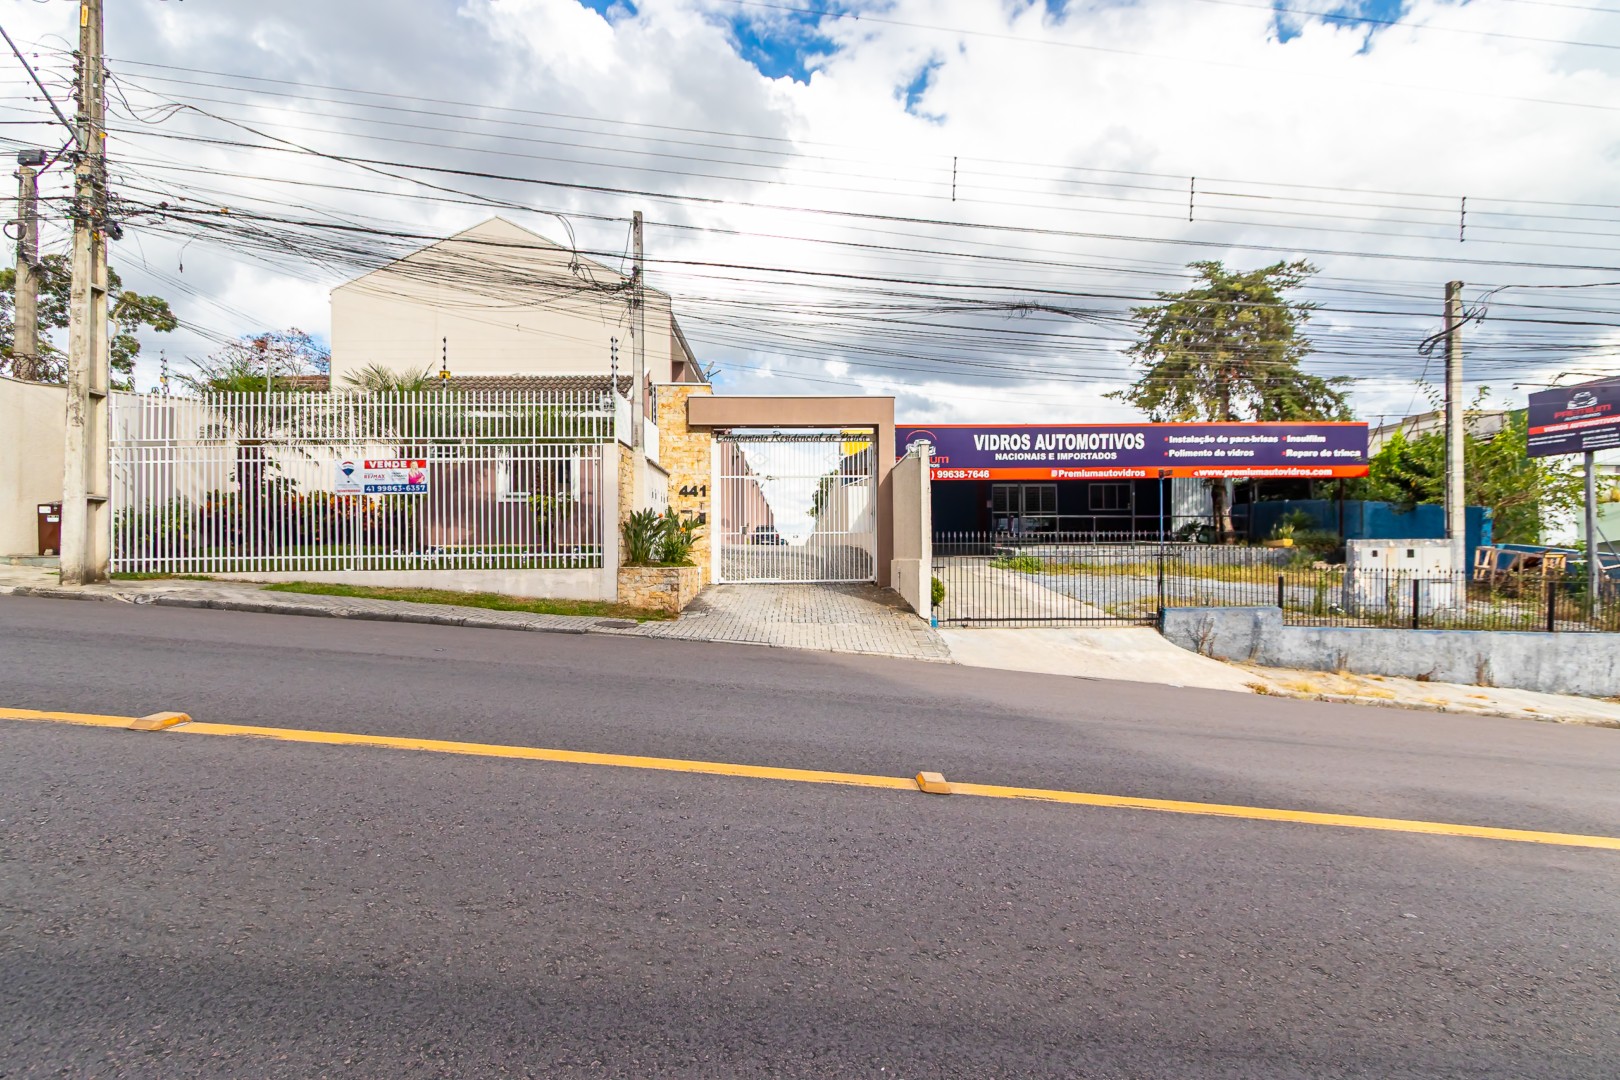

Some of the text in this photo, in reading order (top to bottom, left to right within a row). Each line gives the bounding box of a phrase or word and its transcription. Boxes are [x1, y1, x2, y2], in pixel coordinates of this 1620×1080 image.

[825, 433, 837, 442] de
[973, 433, 1145, 451] VIDROS AUTOMOTIVOS
[1169, 435, 1215, 444] Instalação
[1216, 435, 1228, 443] de
[1057, 452, 1117, 460] IMPORTADOS
[1169, 449, 1212, 457] Polimento
[1286, 449, 1361, 458] Reparo de trinca
[369, 460, 407, 468] VENDE
[937, 470, 989, 478] 99638-7646
[1199, 468, 1332, 477] www.premiumautovidros.com
[679, 485, 706, 497] 441
